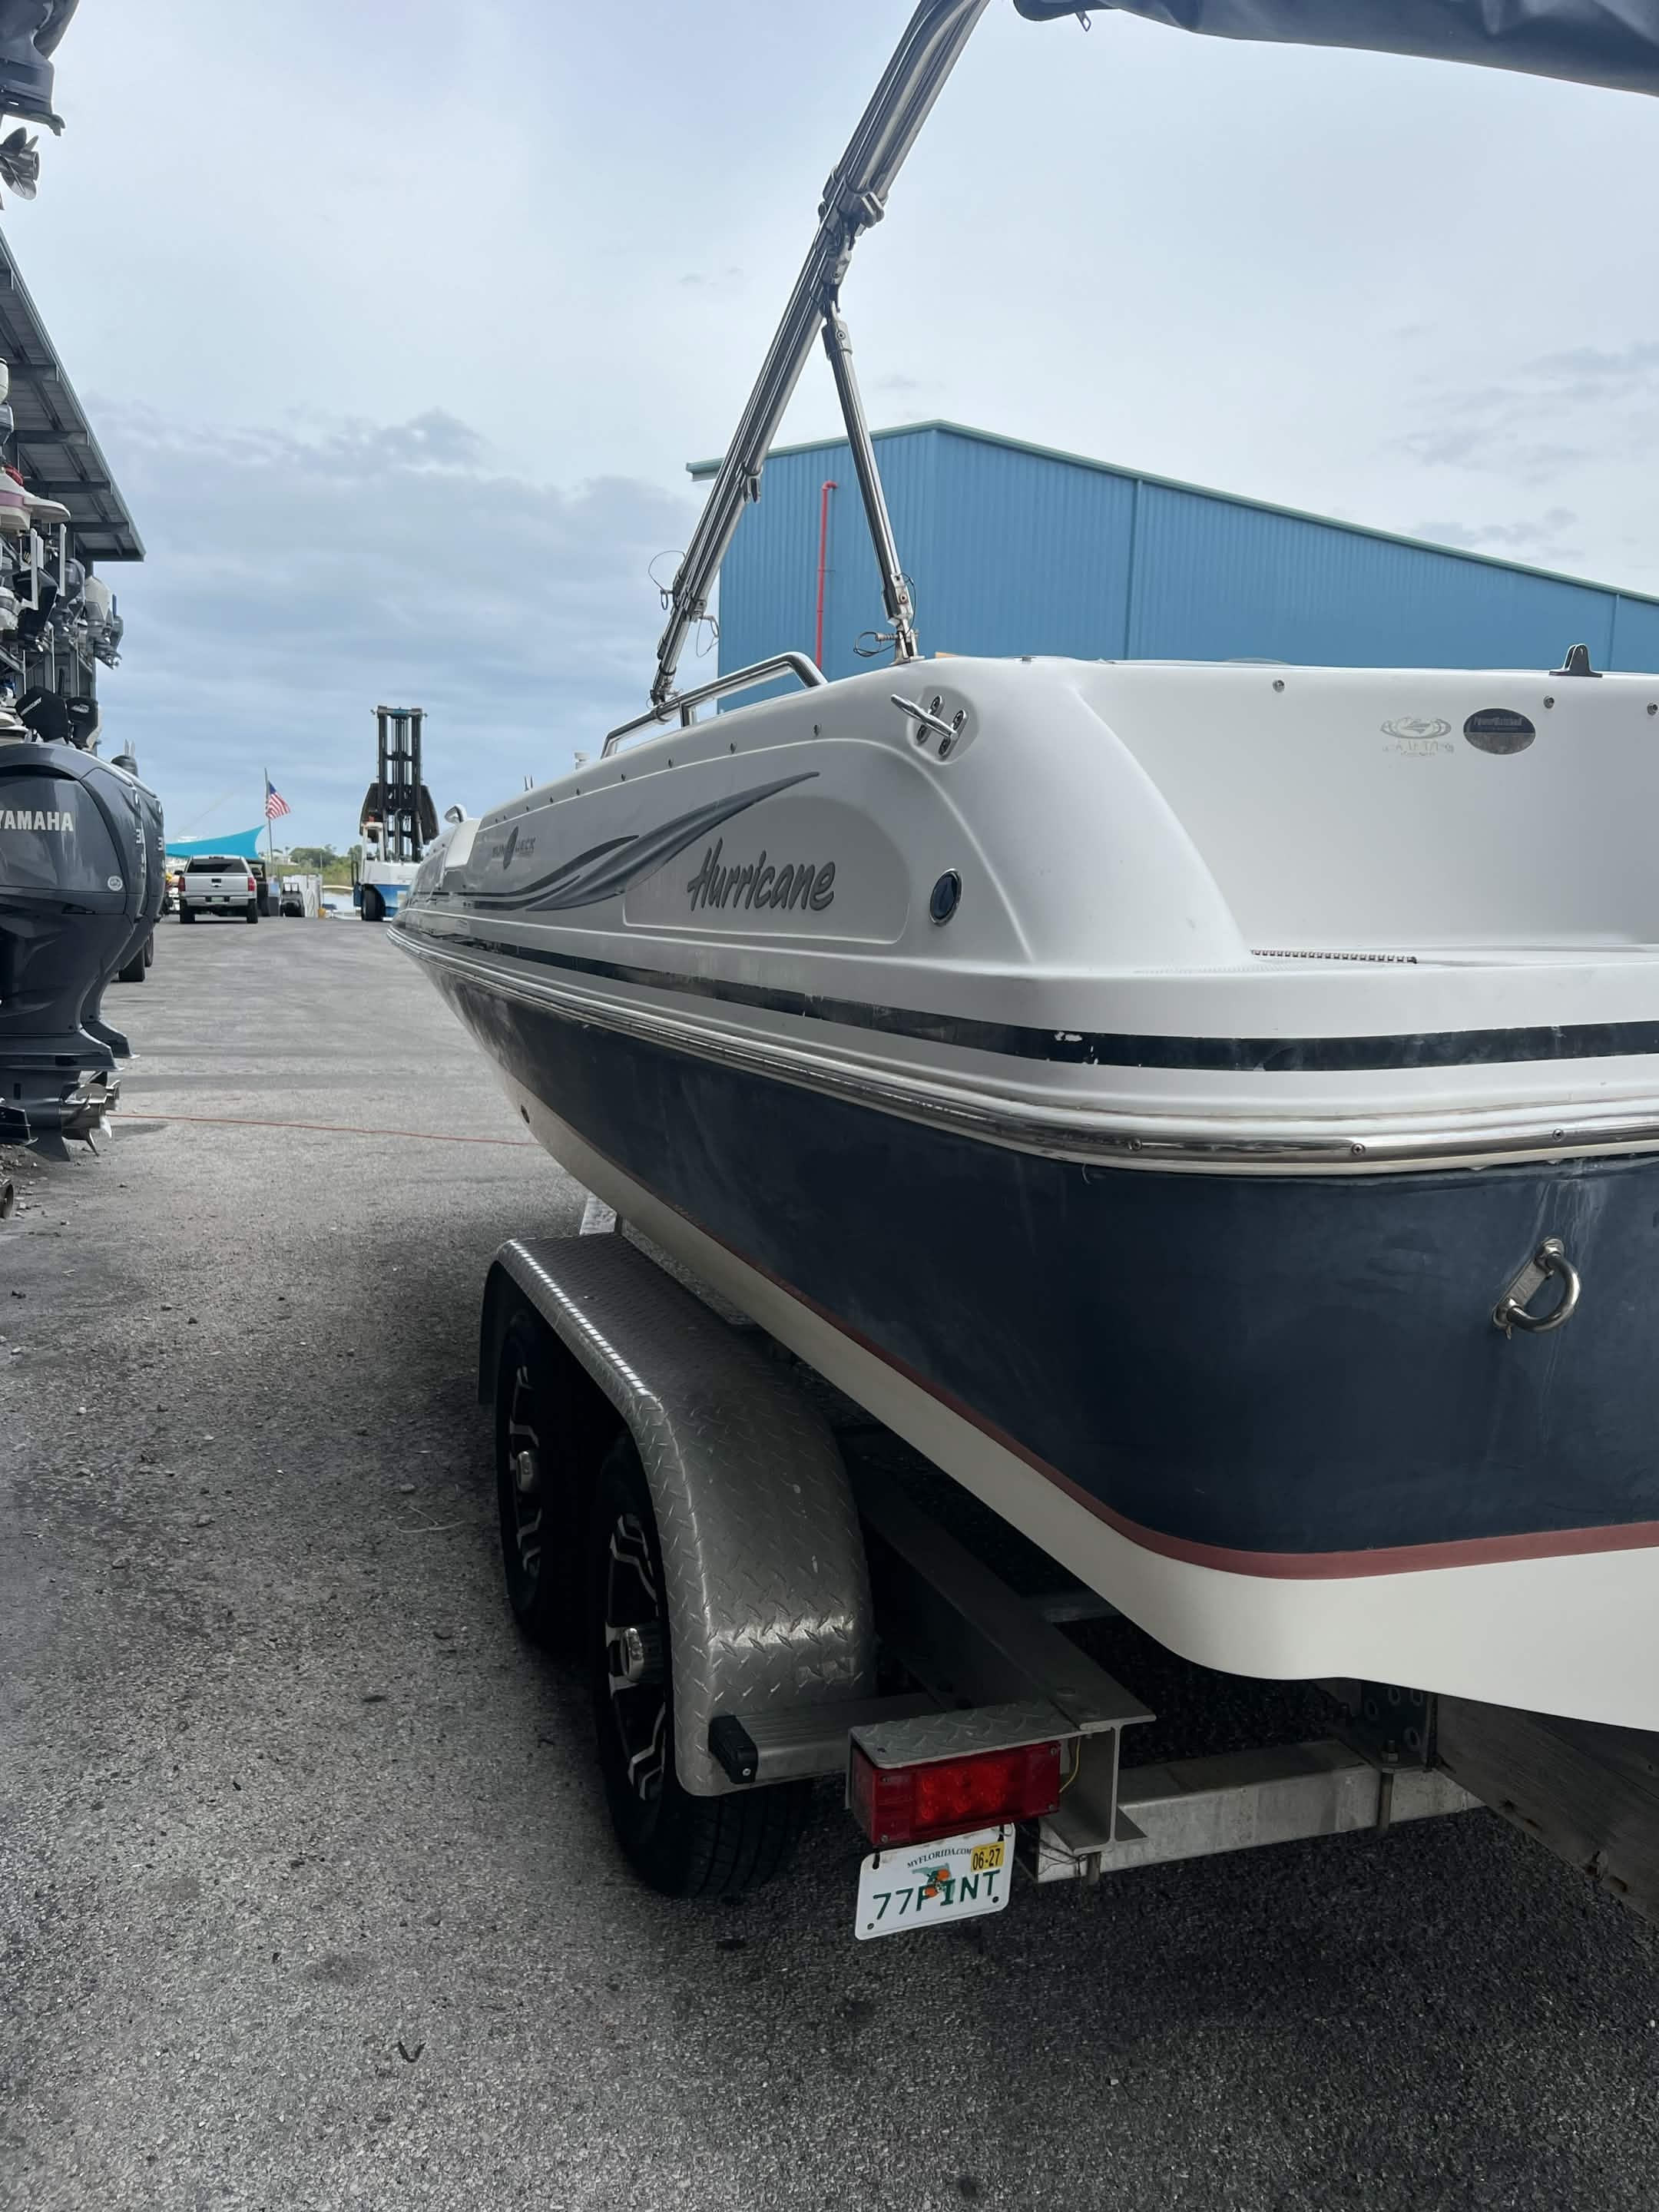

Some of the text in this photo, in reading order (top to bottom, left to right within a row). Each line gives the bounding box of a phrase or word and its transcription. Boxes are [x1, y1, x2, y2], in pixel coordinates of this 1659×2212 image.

[0, 810, 74, 832] YAMAHA
[687, 838, 836, 912] Hurricane
[972, 1848, 1001, 1870] 06-27
